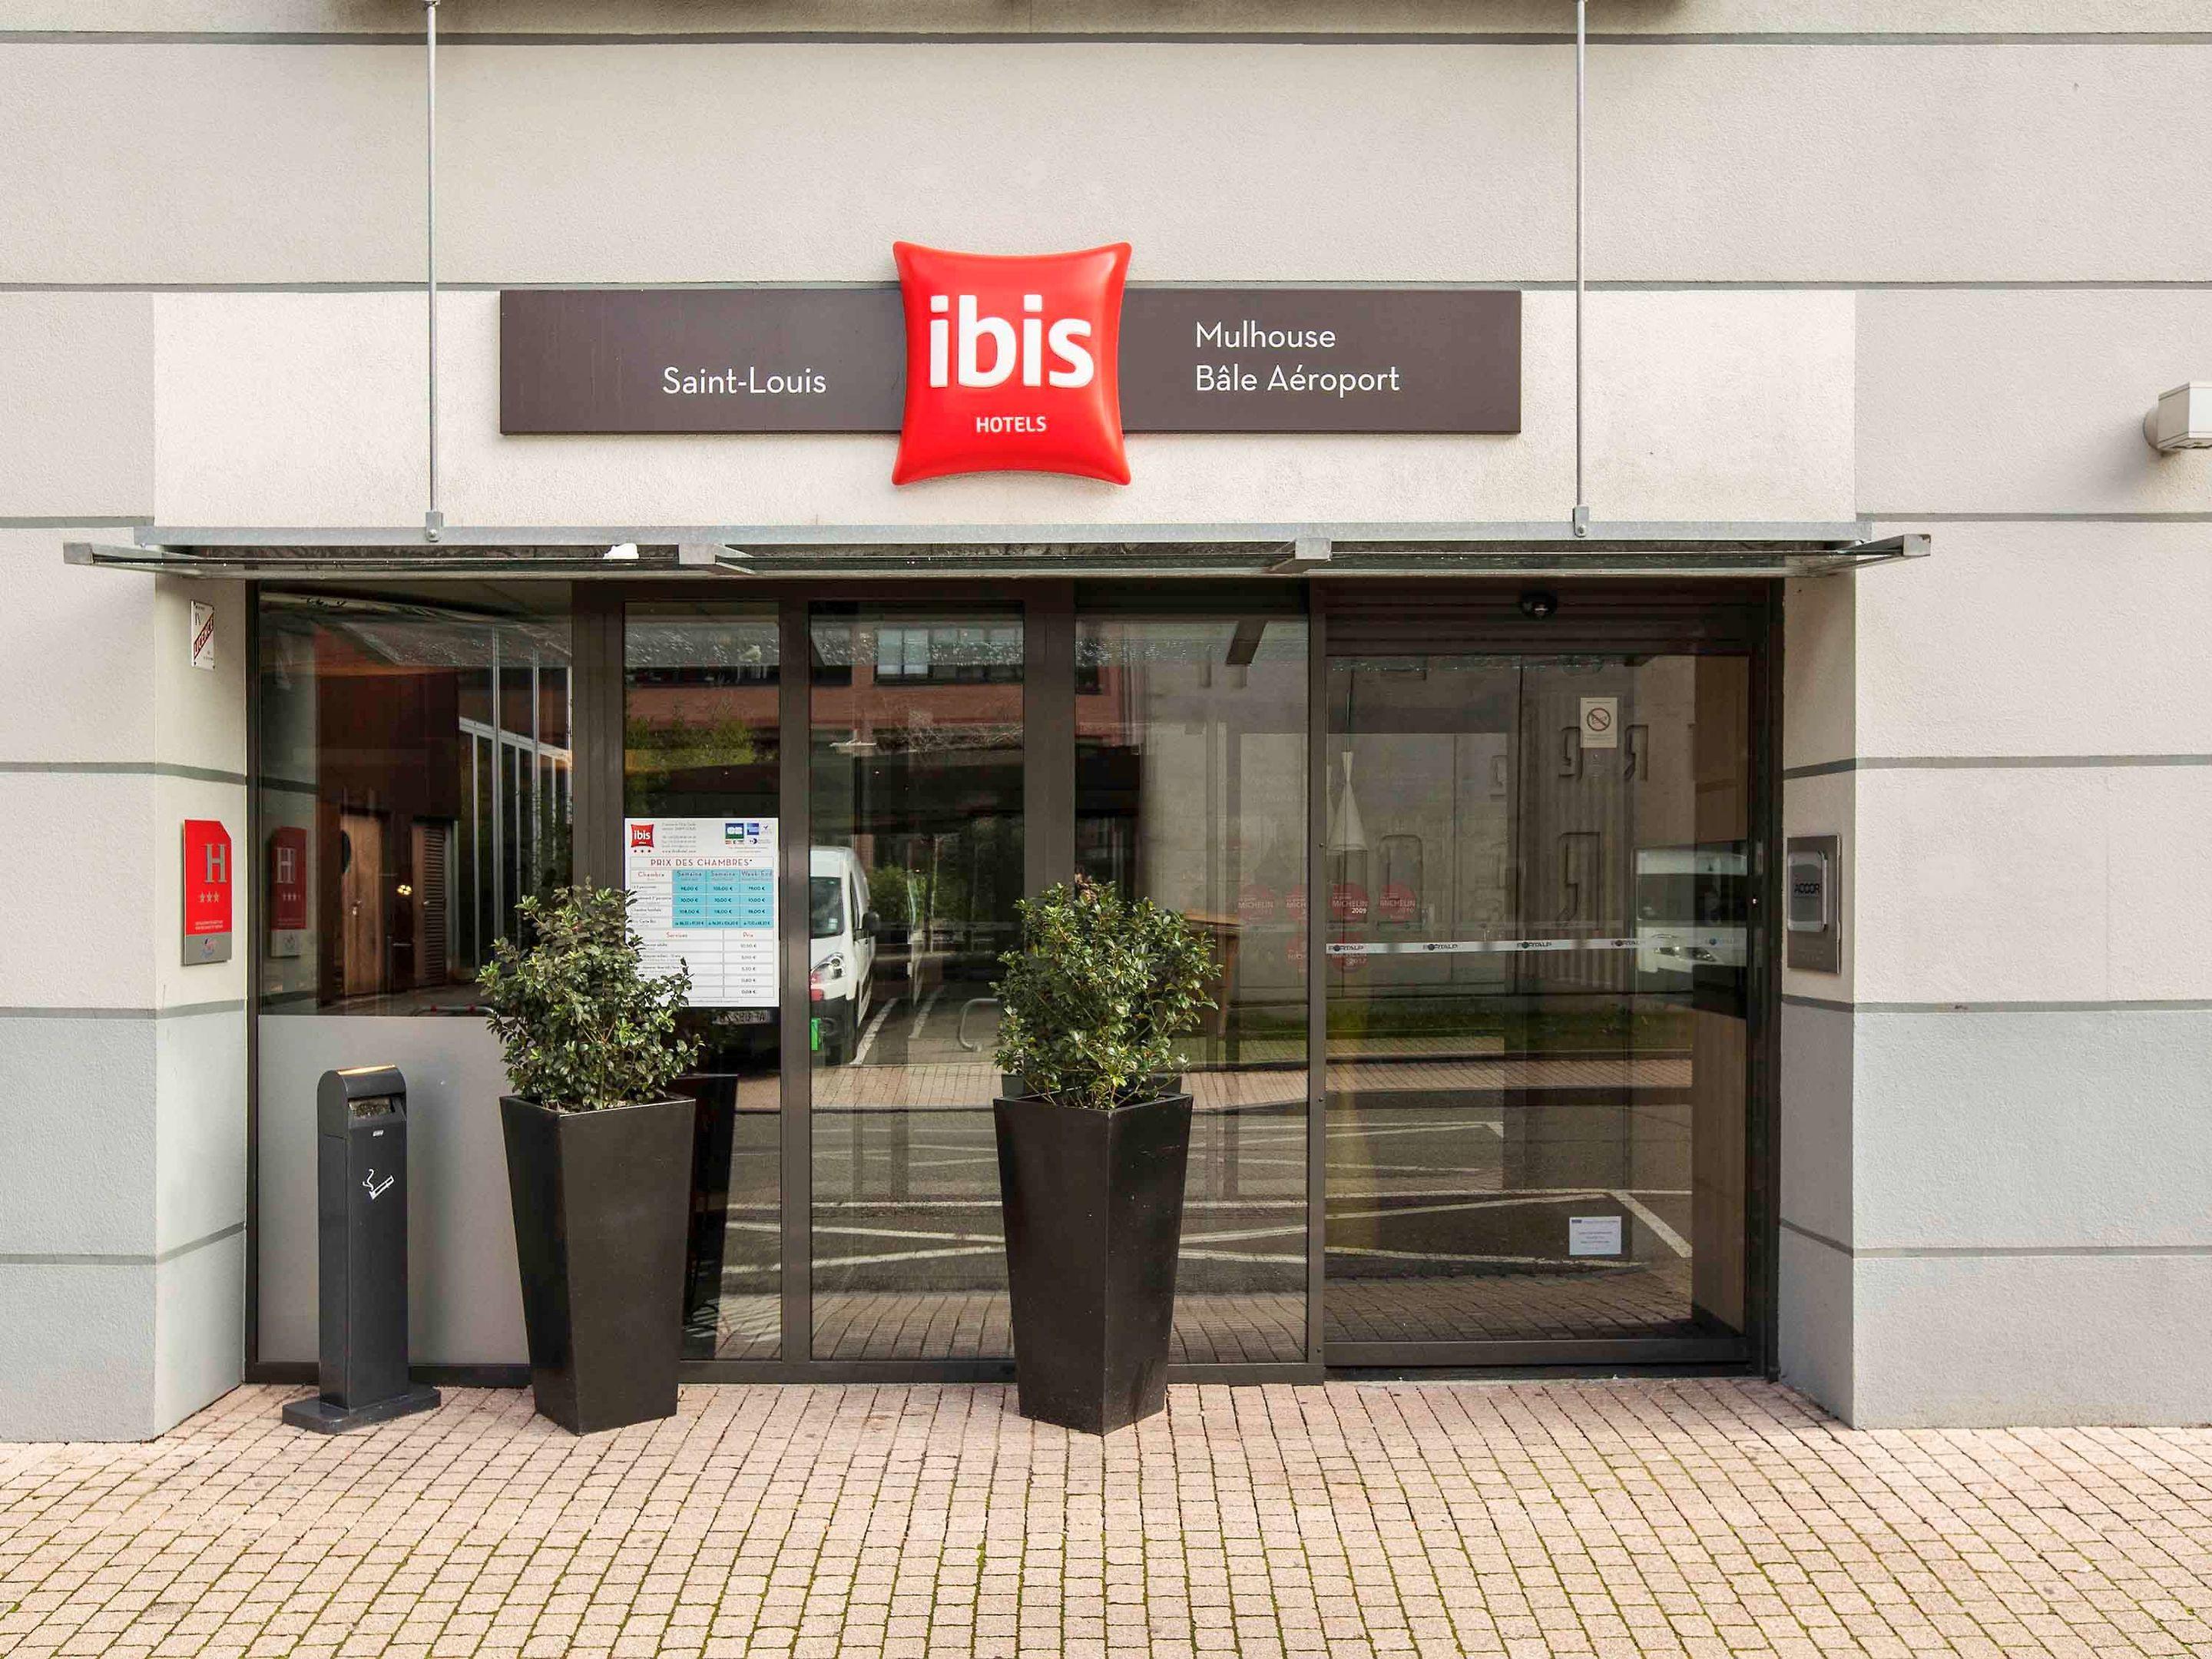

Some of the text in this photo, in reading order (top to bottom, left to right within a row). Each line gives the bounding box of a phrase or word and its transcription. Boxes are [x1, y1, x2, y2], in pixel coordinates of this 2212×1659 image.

[930, 294, 1094, 388] ibis
[1196, 320, 1336, 348] Mulhouse
[662, 366, 827, 395] Saint-Louis
[1196, 363, 1400, 399] Bâle Aéroport
[975, 416, 1048, 433] HOTELS
[194, 615, 214, 658] LICENCE
[634, 830, 651, 840] ibis
[204, 843, 227, 884] H
[650, 859, 672, 867] PRIX
[676, 859, 694, 867] DES
[1332, 899, 1369, 908] MICHELIN
[1379, 899, 1416, 908] MICHELIN
